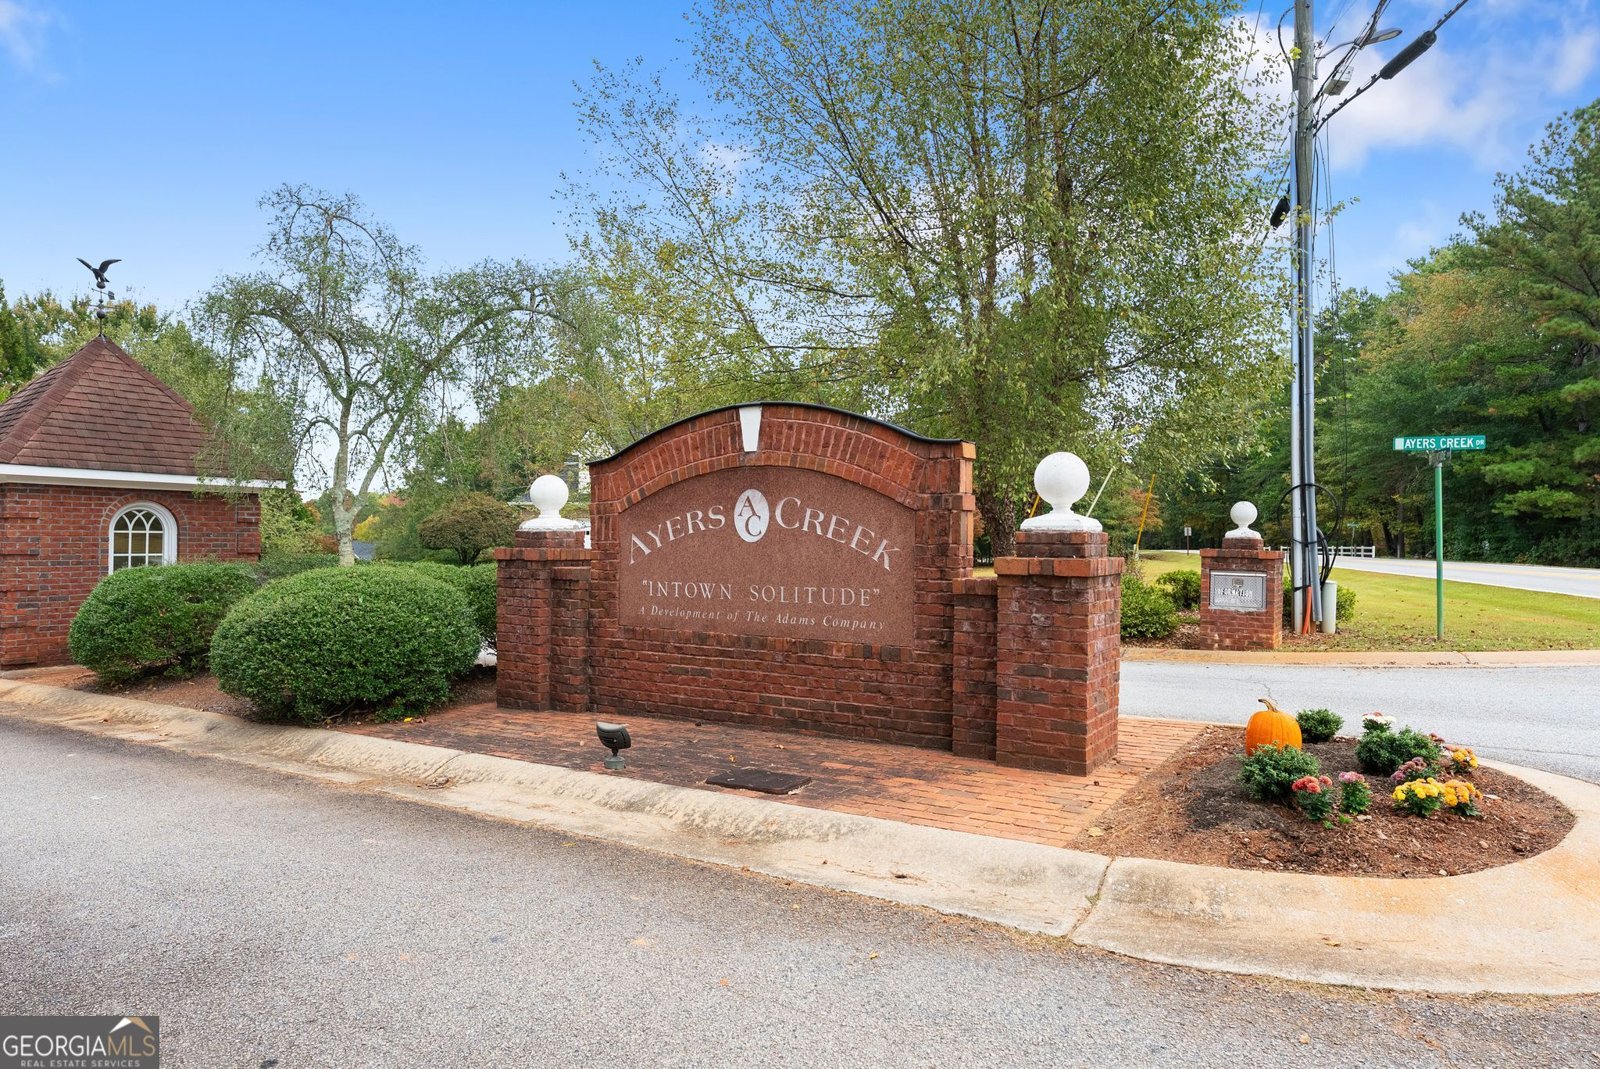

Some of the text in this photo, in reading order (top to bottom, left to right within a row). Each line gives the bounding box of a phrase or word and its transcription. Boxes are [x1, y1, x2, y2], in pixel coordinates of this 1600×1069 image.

[1404, 438, 1436, 449] AYERS
[1440, 437, 1474, 448] CREEK
[628, 496, 900, 572] AYERS CREEK
[639, 605, 886, 632] A Development of The Adams Company
